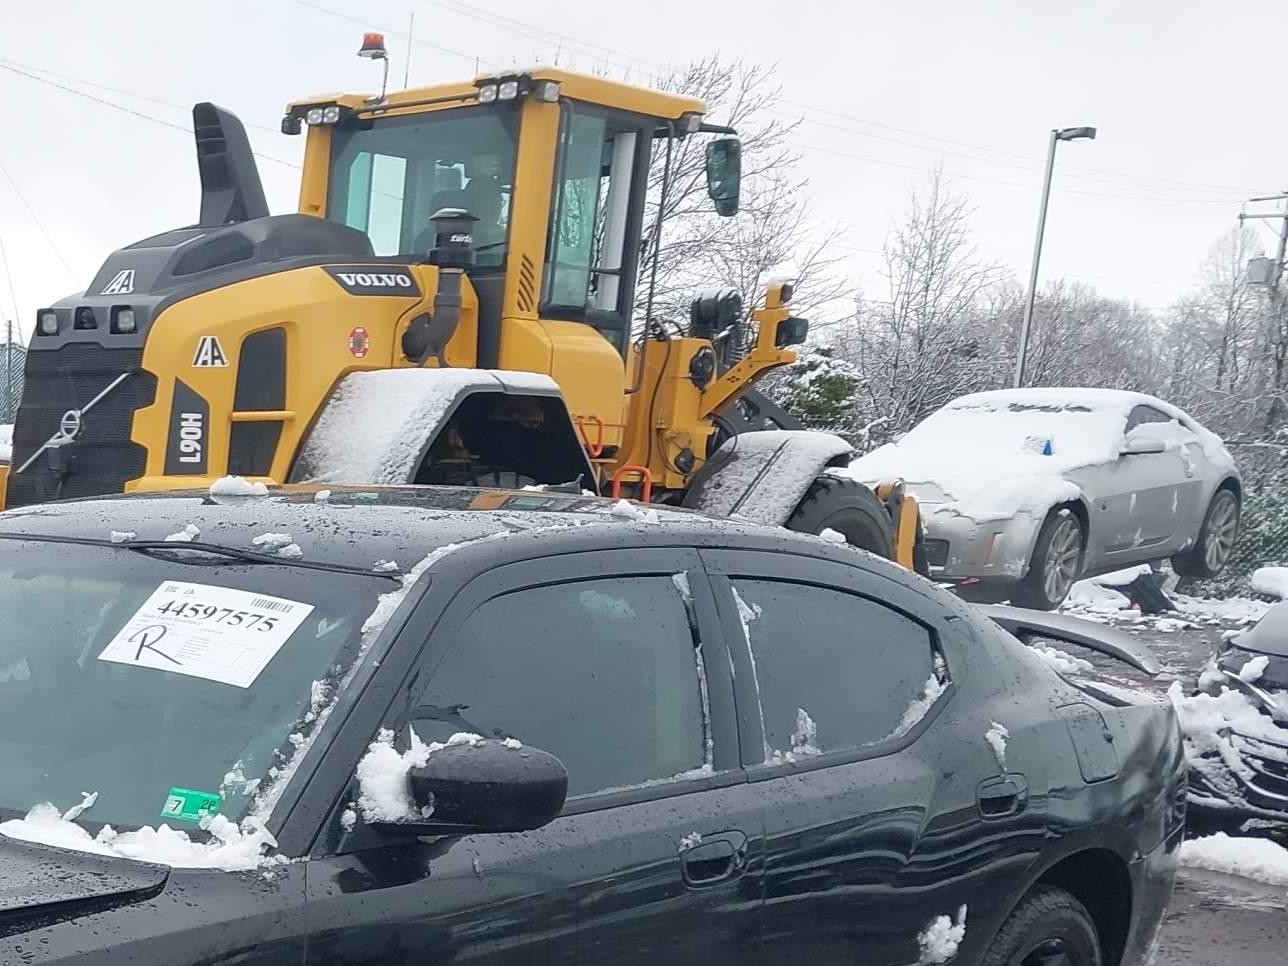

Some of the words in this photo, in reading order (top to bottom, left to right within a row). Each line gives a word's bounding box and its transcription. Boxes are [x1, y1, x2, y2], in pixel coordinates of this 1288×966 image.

[336, 273, 412, 288] VOLVO
[179, 412, 203, 463] L90H
[157, 600, 281, 633] 44597575
[127, 624, 184, 666] R
